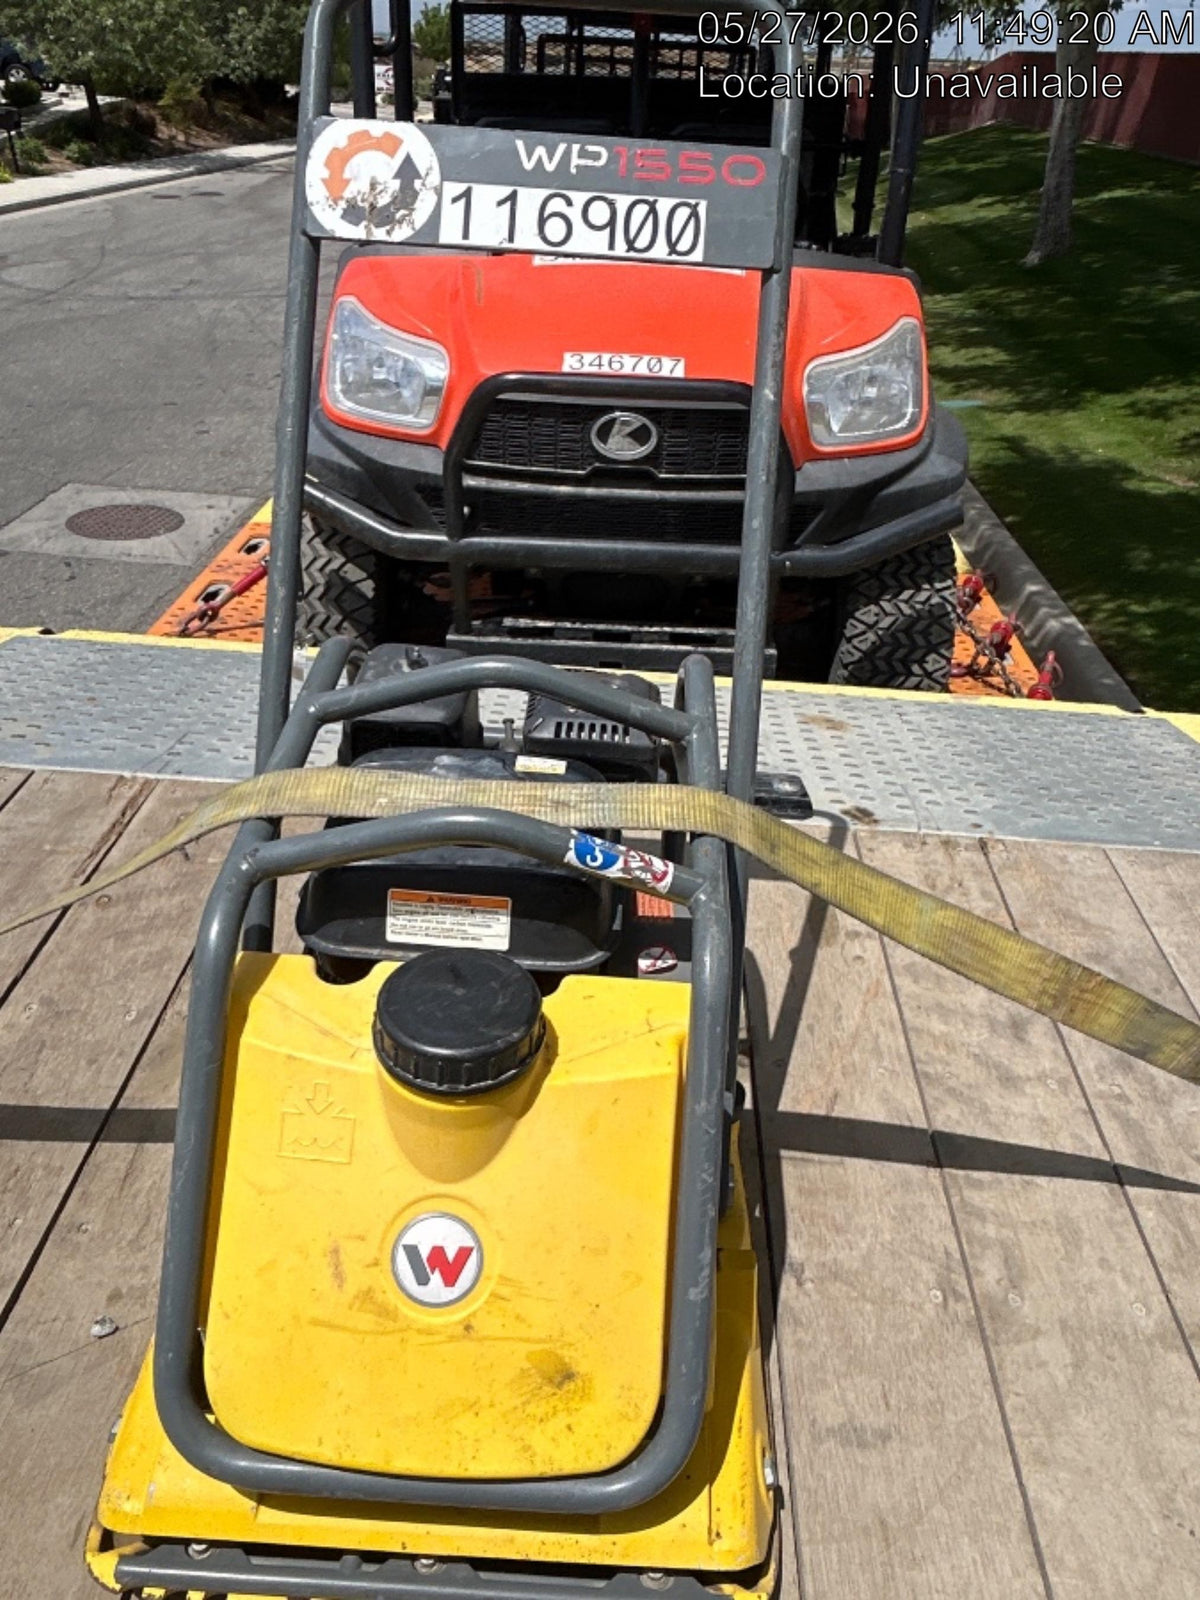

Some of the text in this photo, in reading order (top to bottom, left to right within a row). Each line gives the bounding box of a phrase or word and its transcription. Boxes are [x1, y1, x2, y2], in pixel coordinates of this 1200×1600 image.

[515, 138, 767, 188] WP1550
[450, 185, 702, 258] 116900
[568, 352, 682, 376] 346707
